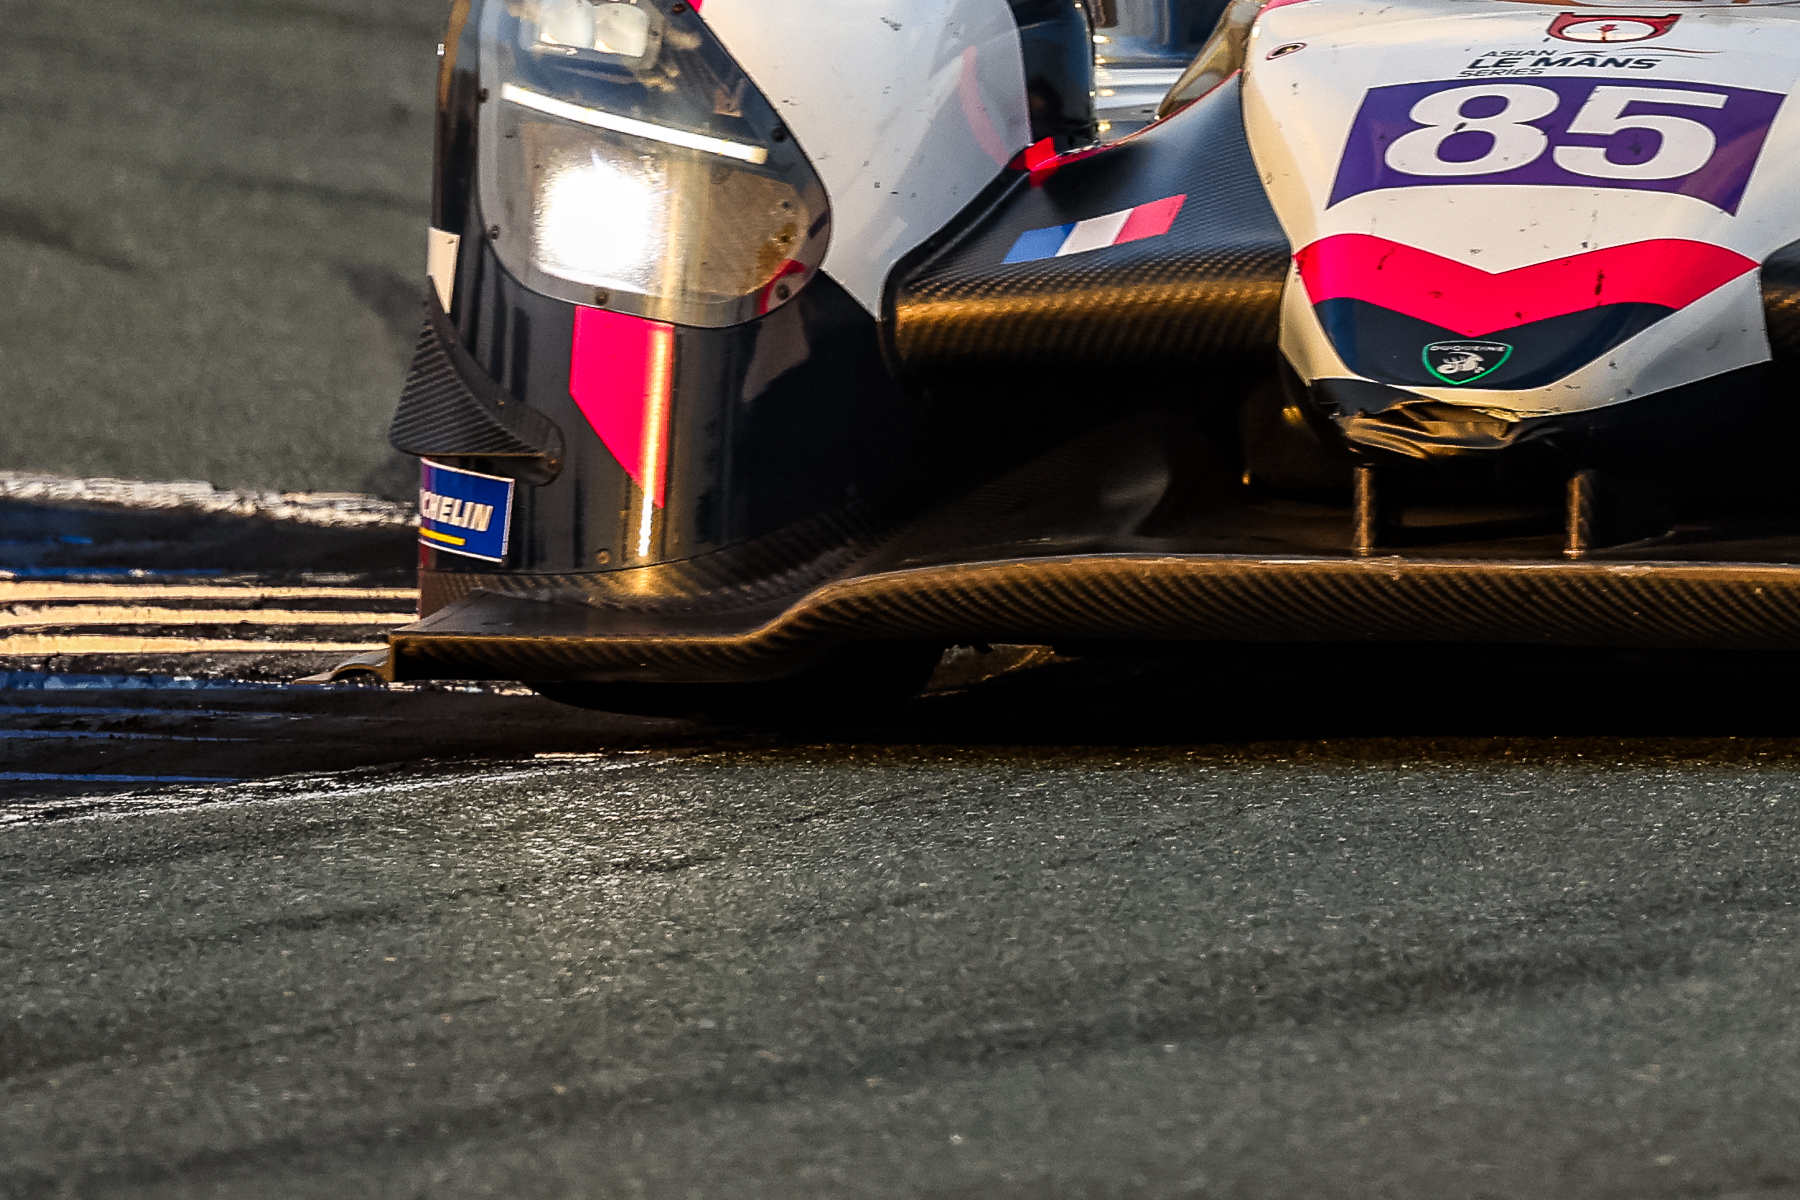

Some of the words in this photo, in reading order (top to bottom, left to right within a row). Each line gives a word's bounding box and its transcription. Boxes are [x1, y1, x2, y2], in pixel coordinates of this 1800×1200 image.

[1480, 49, 1558, 58] ASIAN
[1467, 57, 1523, 69] LE
[1529, 57, 1662, 69] MANS
[1456, 67, 1547, 77] SERIES
[1384, 84, 1730, 180] 85
